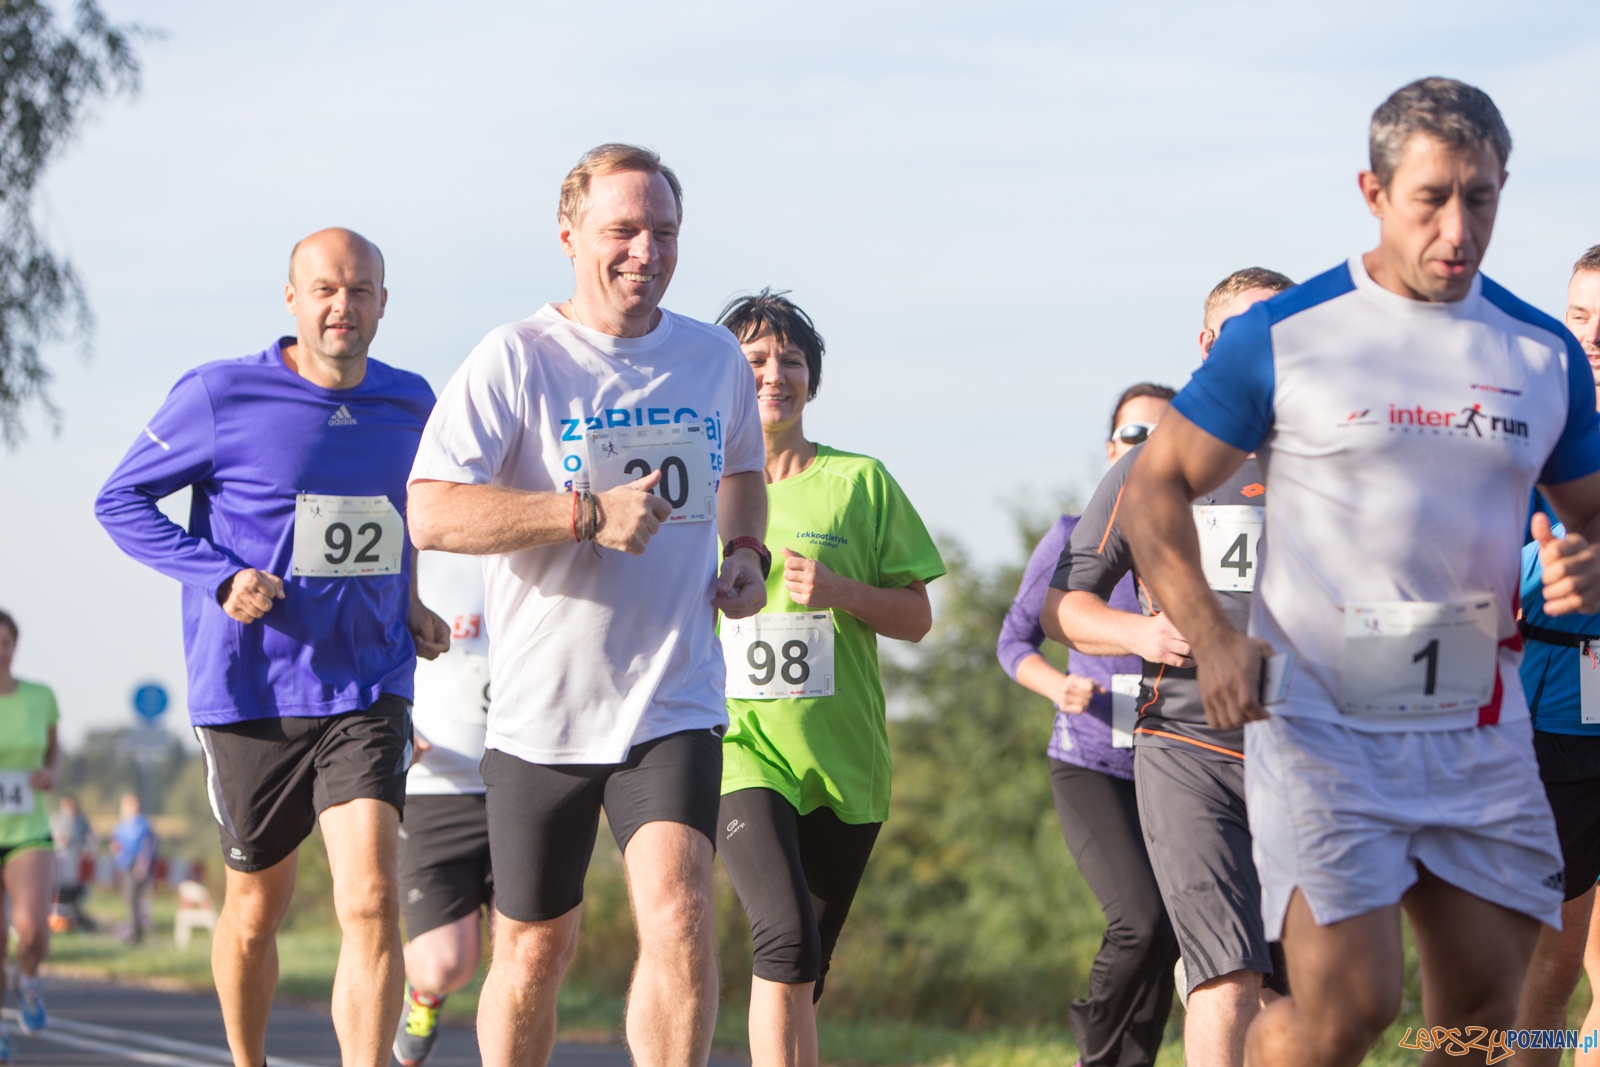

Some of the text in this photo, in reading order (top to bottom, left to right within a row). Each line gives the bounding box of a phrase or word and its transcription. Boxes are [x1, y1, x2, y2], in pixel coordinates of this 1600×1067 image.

[328, 418, 357, 427] adidas
[1389, 404, 1529, 438] inter run
[324, 522, 383, 564] 92
[1220, 533, 1260, 577] 4
[747, 639, 810, 686] 98
[1412, 639, 1439, 695] 1
